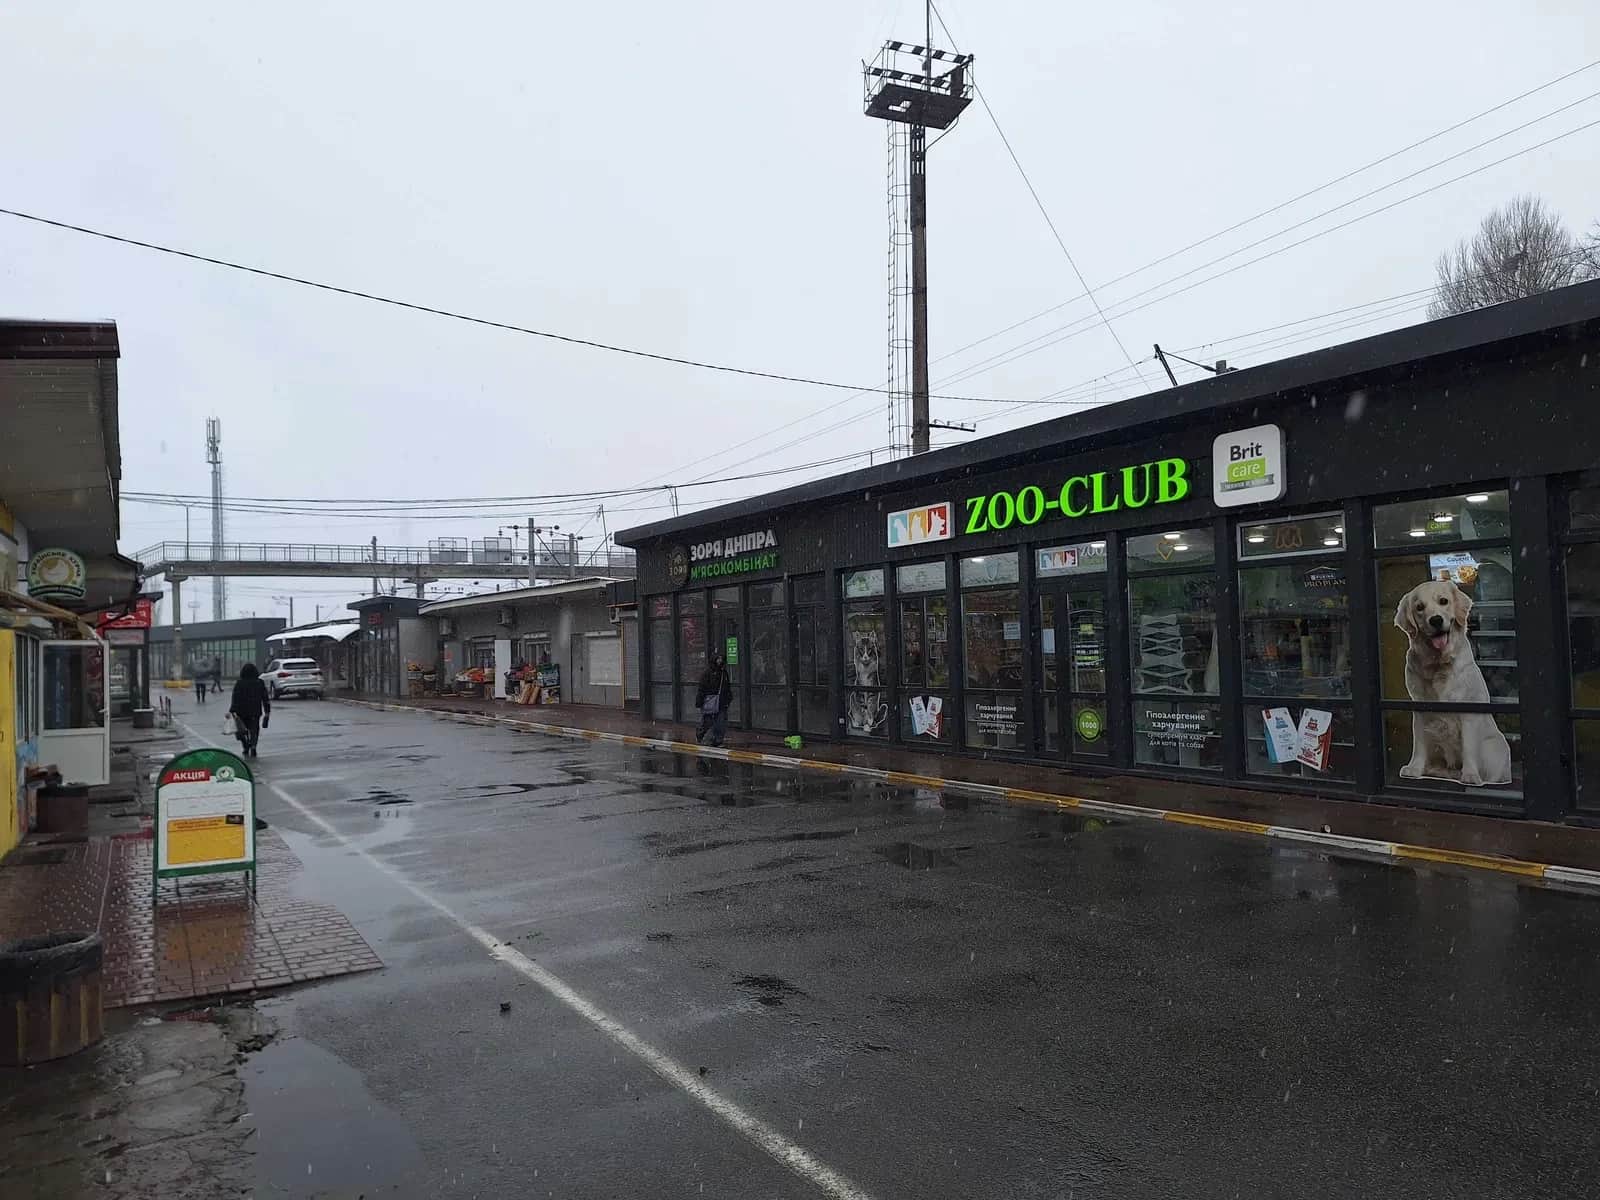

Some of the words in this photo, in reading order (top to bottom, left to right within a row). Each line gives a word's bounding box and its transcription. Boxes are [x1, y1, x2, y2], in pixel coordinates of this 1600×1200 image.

[1230, 442, 1262, 461] Brit
[1232, 463, 1260, 478] care
[963, 457, 1190, 535] ZOO-CLUB
[690, 539, 723, 562] ЗОРЯ
[724, 529, 778, 558] ДНІПРА
[690, 551, 777, 579] М'ЯСОКОМБІНАТ
[1145, 710, 1206, 722] Гіпоалергенне
[1152, 721, 1200, 731] харчування
[173, 771, 206, 781] АКЦІЯ
